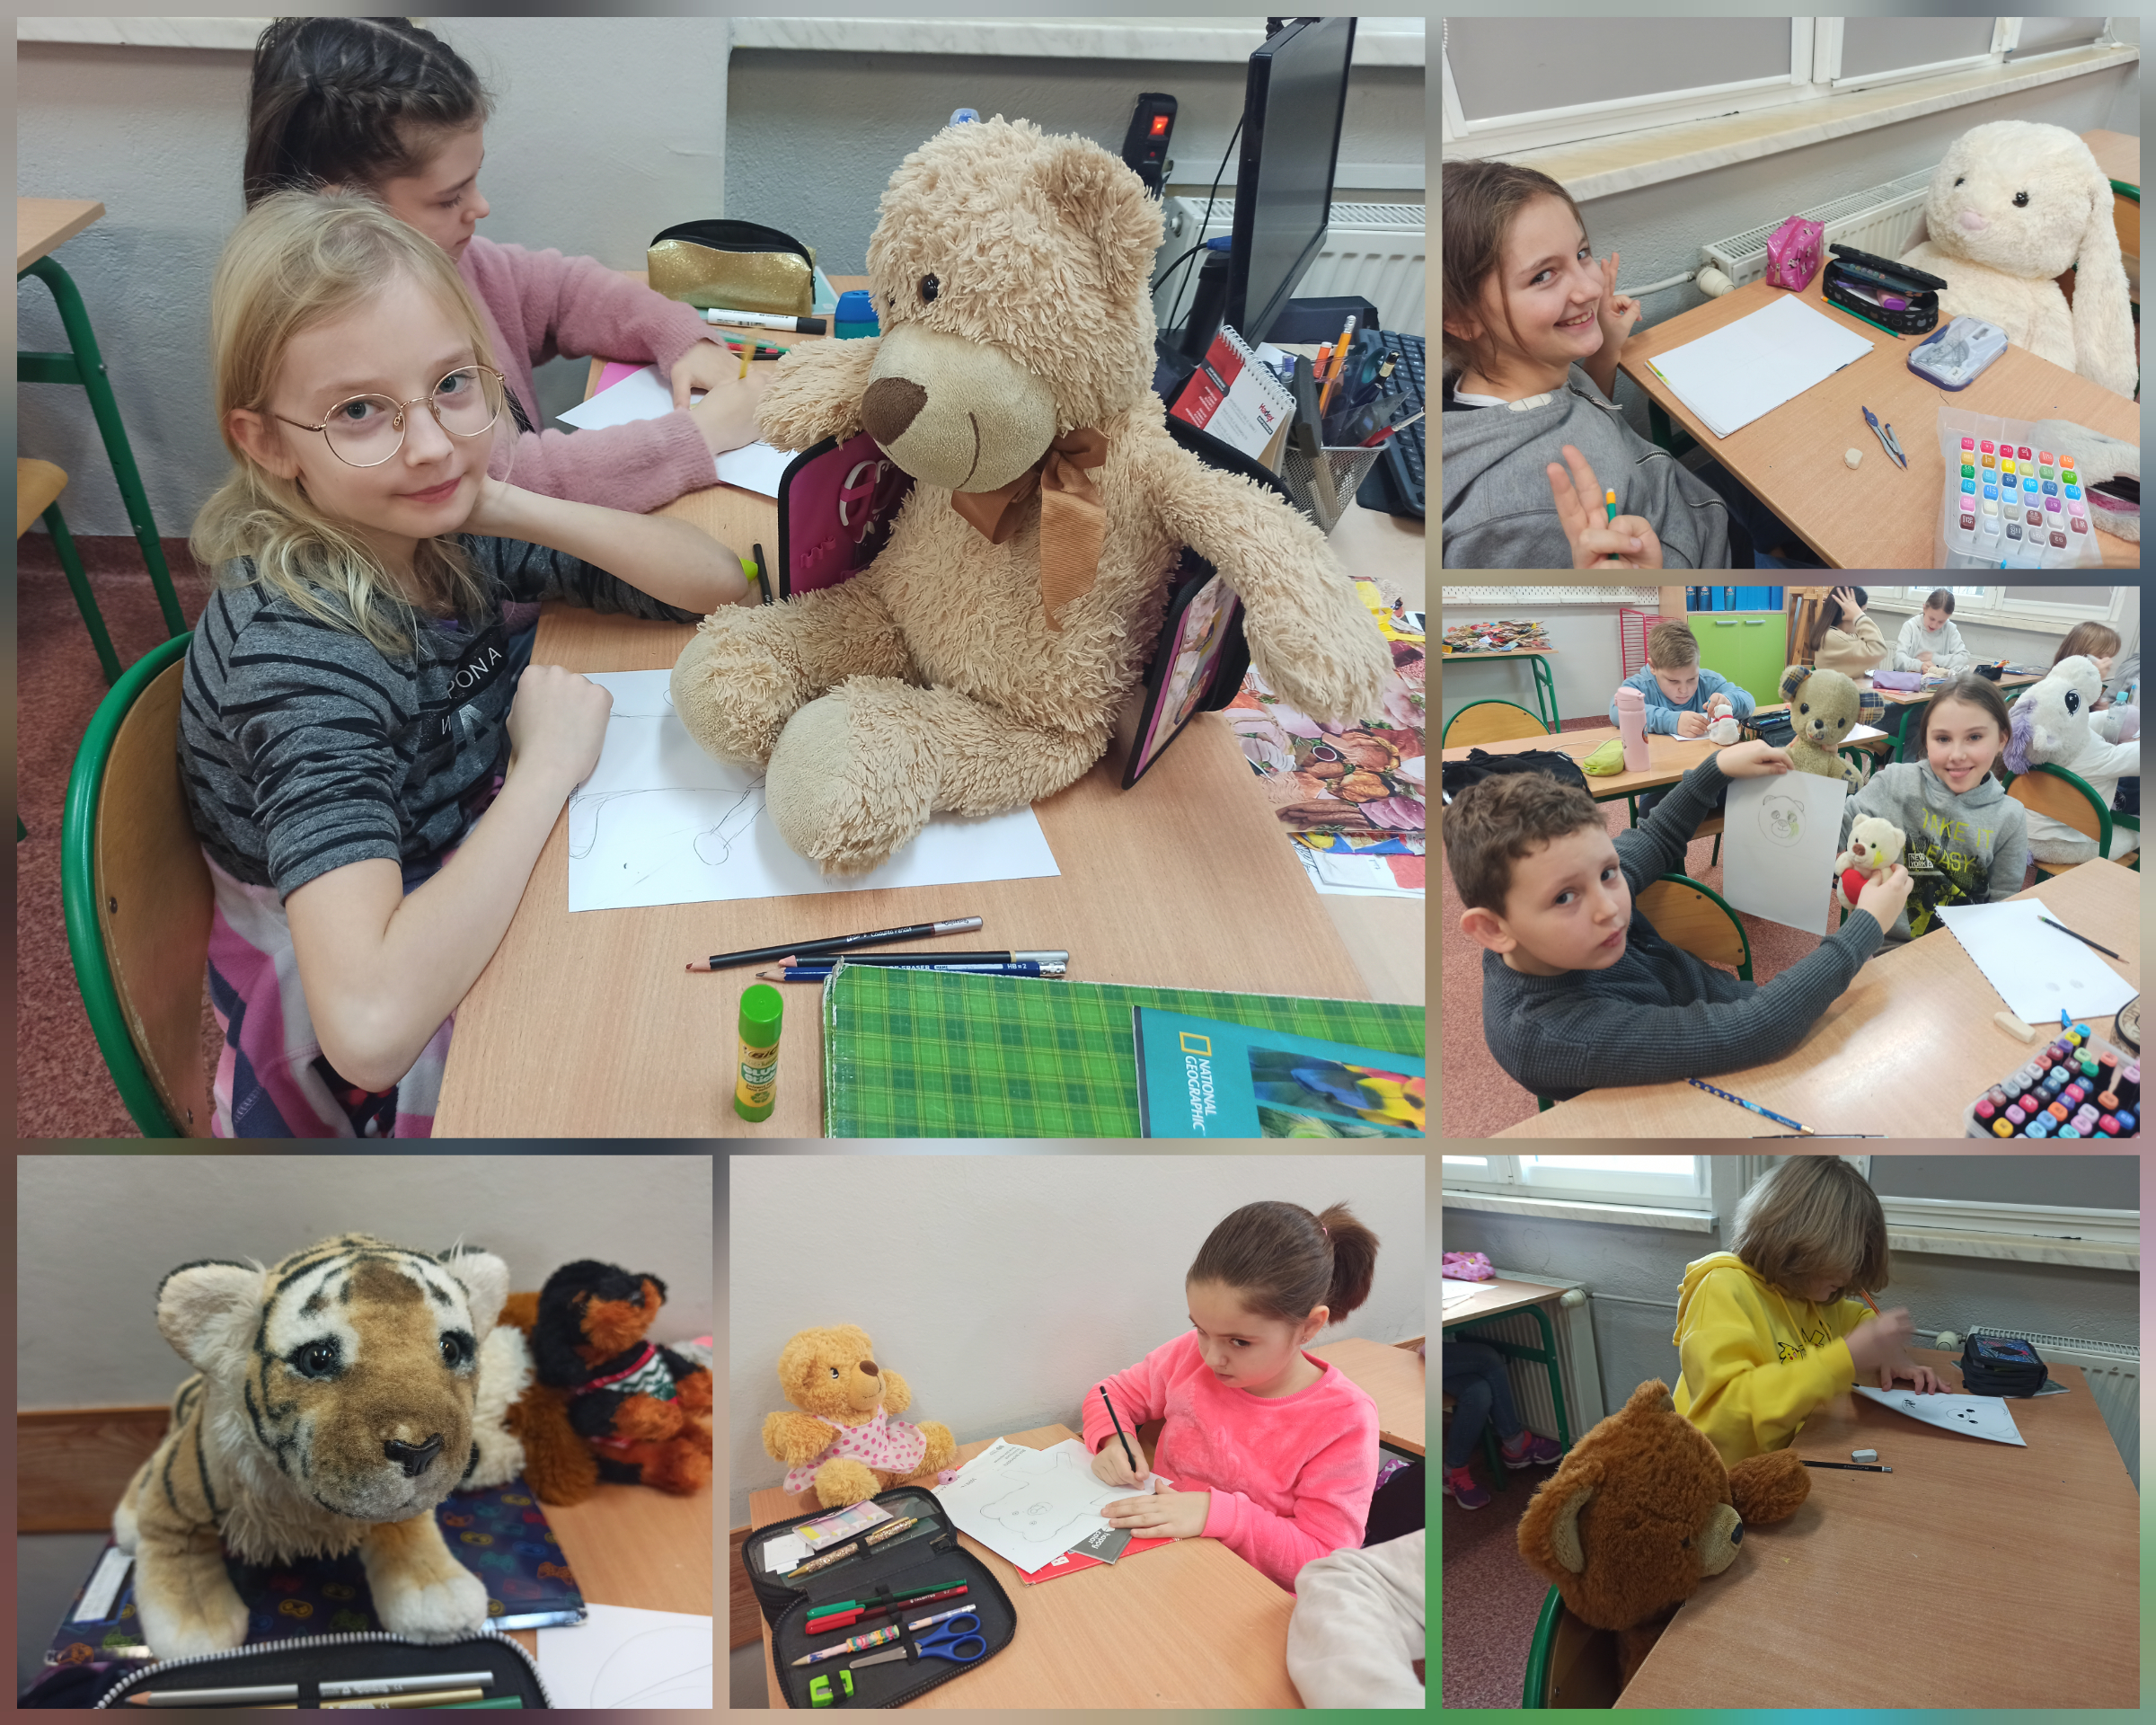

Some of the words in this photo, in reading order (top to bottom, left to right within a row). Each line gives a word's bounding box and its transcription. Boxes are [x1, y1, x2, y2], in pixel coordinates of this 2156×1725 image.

[1259, 402, 1276, 423] Hadex
[1922, 808, 1969, 842] TAKE
[1976, 827, 1993, 849] IT
[1925, 845, 1975, 872] EASY
[752, 1045, 779, 1058] BIC
[743, 1060, 778, 1076] GLUE
[745, 1070, 776, 1084] Stick
[1185, 1056, 1205, 1131] GEOGRAPHIC
[1198, 1058, 1216, 1116] NATIONAL
[1088, 1531, 1100, 1545] color
[1093, 1532, 1111, 1549] happy
